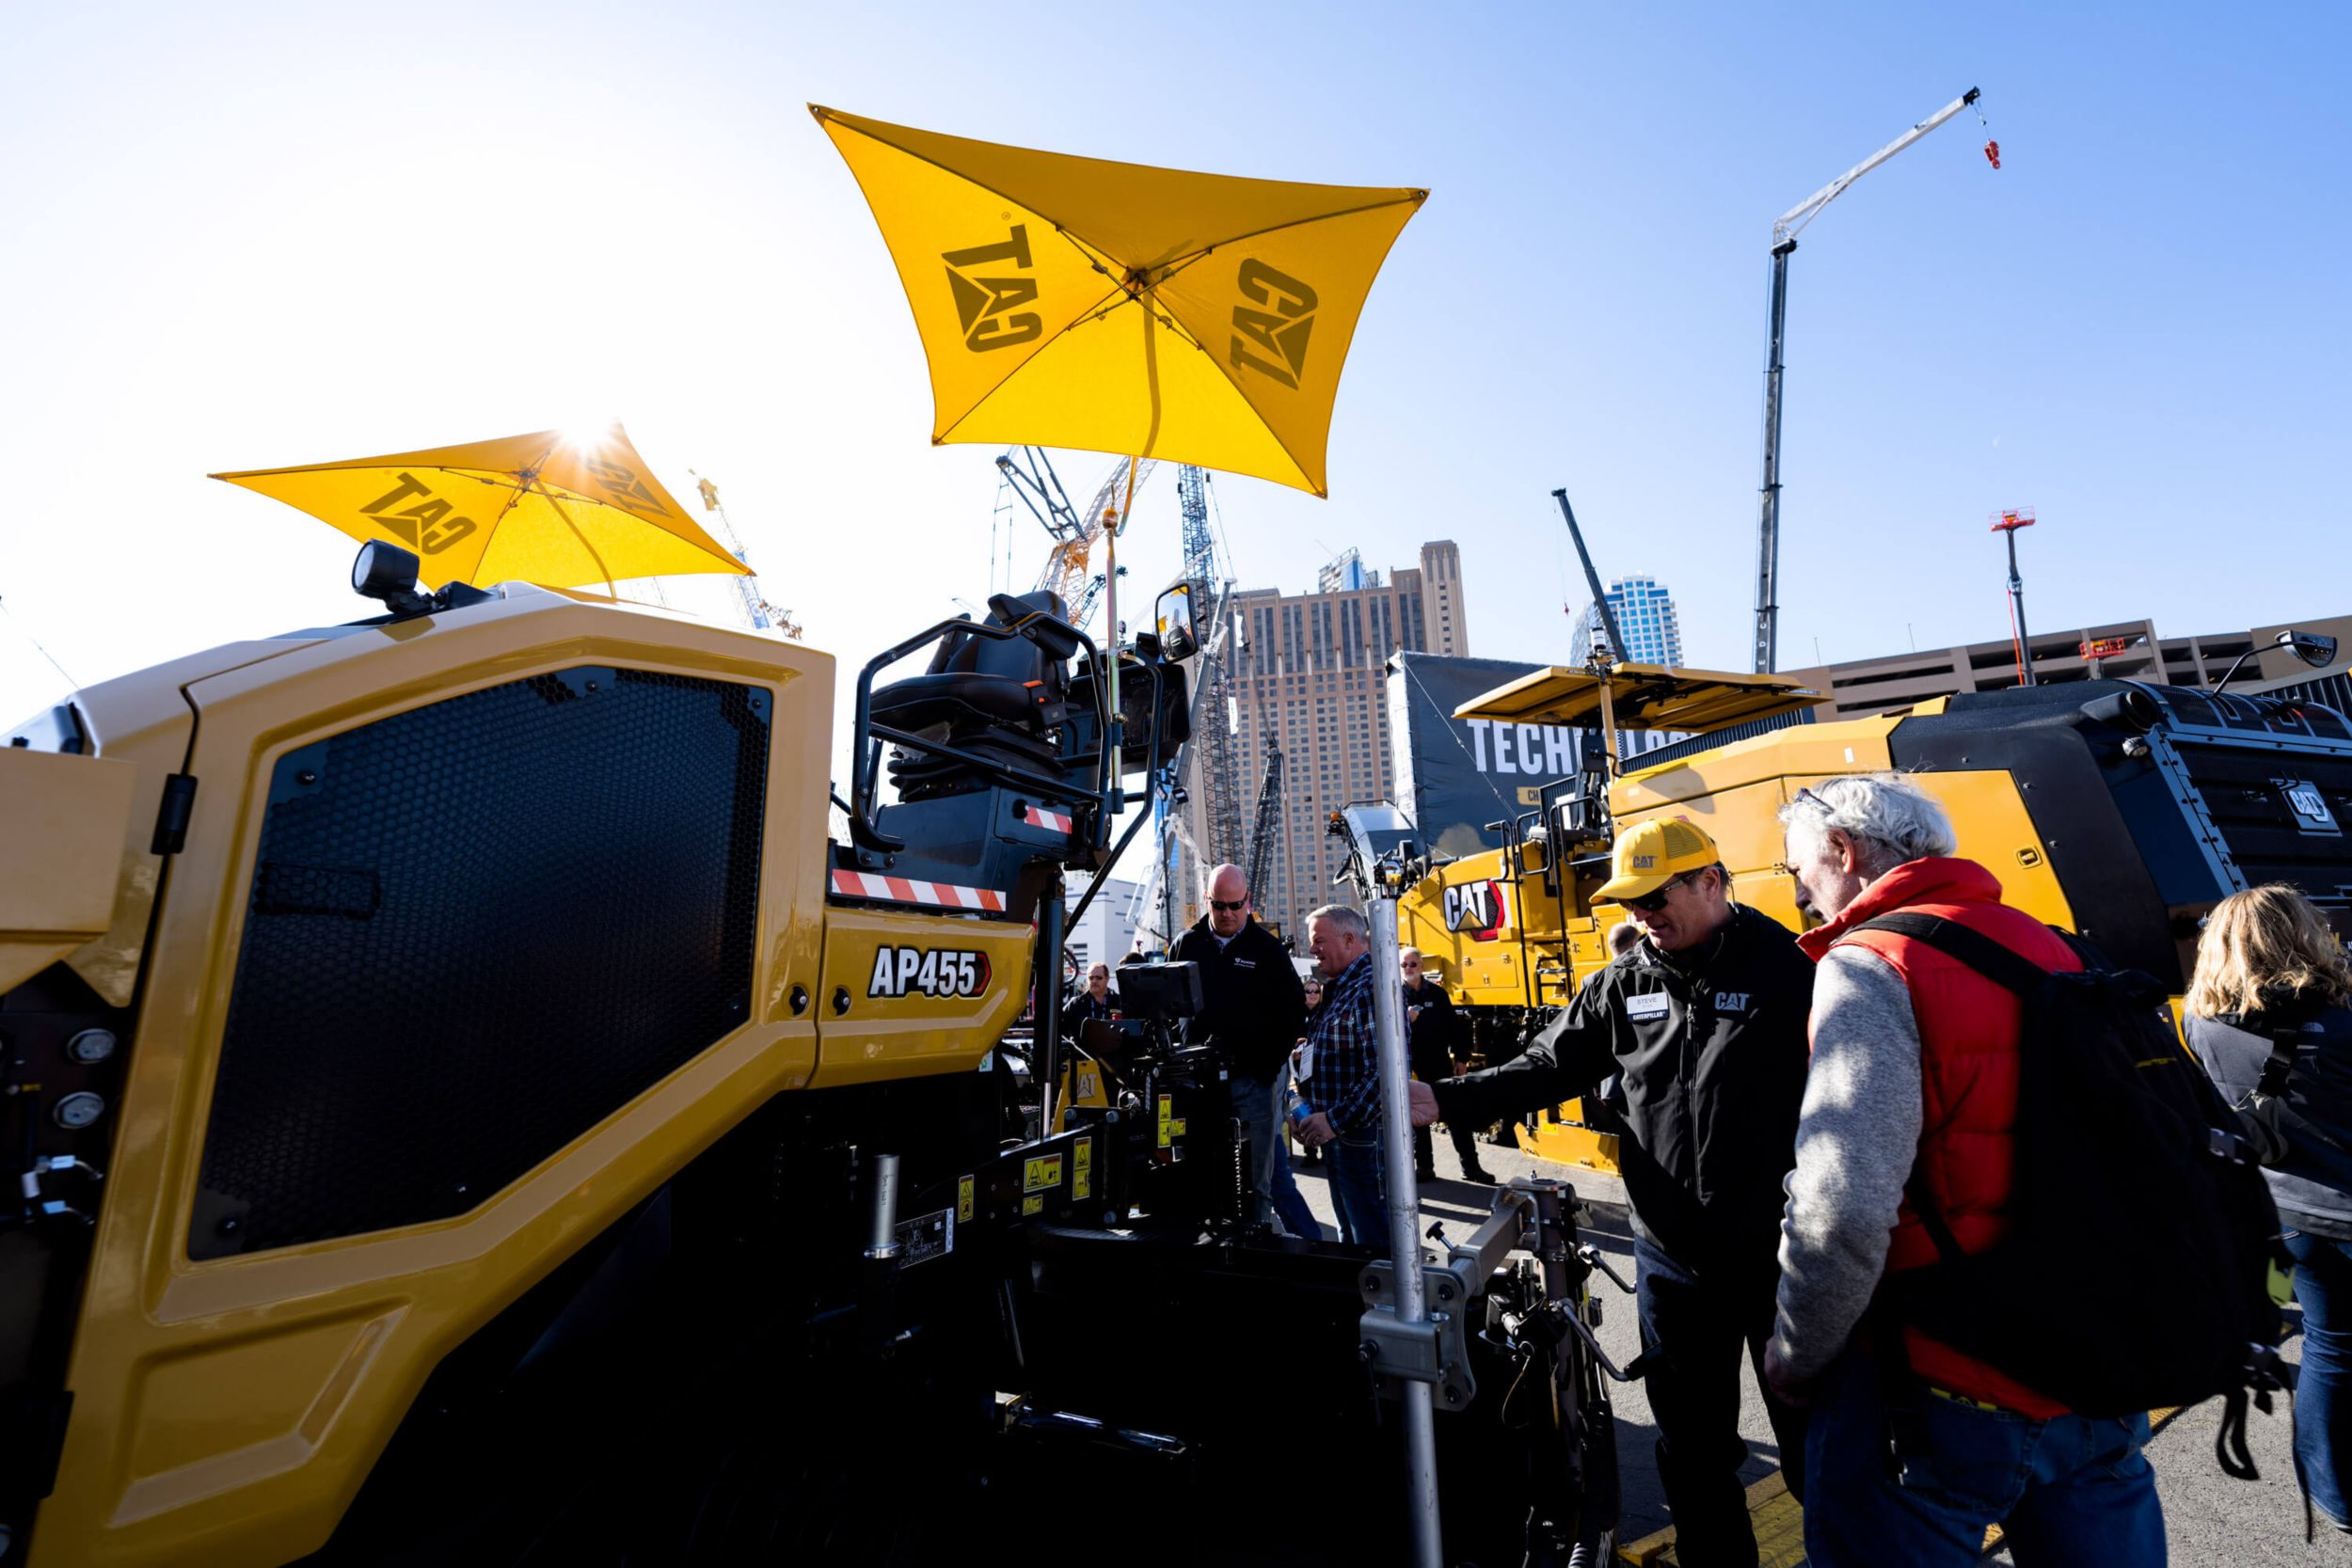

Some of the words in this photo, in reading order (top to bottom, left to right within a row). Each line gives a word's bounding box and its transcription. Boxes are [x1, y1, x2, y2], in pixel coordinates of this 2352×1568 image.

[2288, 789, 2323, 816] CAT
[1632, 853, 1657, 868] CAT
[1443, 880, 1488, 931] CAT
[868, 947, 977, 995] AP455
[1636, 996, 1658, 1006] STEVE
[1714, 990, 1750, 1013] CAT
[1073, 1073, 1098, 1099] AT
